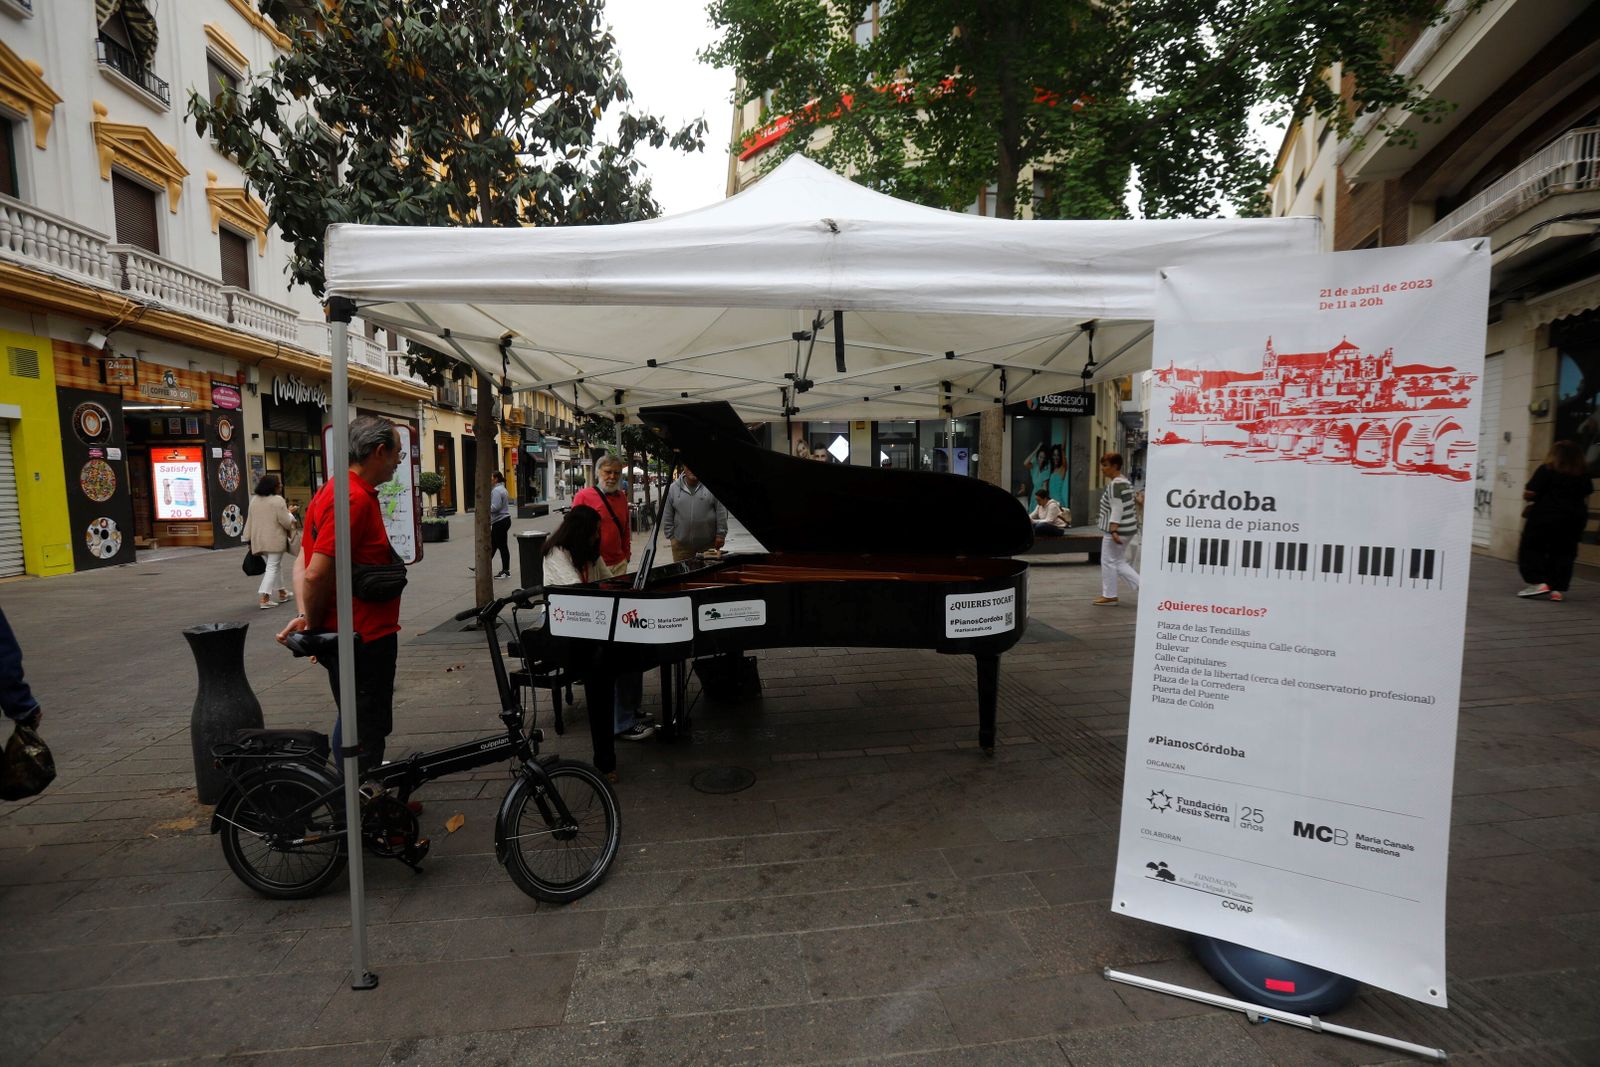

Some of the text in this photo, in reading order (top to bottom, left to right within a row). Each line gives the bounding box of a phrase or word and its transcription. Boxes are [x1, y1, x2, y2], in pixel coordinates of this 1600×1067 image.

[1320, 279, 1433, 298] 21 de abril de 2023
[1320, 302, 1334, 310] De
[1337, 301, 1346, 309] 11
[1360, 297, 1383, 307] 20h
[150, 387, 170, 396] COFFEE
[170, 390, 178, 398] TO
[160, 466, 198, 474] Satisfyer
[1166, 489, 1277, 512] Córdoba
[170, 510, 192, 518] 20 €
[1166, 516, 1300, 532] se llena de pianos
[950, 599, 992, 610] ¿QUIERES
[1157, 600, 1268, 617] ¿Quieres tocarlos?
[595, 610, 606, 620] 25
[622, 609, 638, 624] OFF
[630, 618, 656, 630] MCB
[1157, 621, 1250, 636] Plaza de las Tendillas
[1156, 632, 1336, 656] Calle Cruz Conde esquina Calle Góngora
[1156, 642, 1190, 652] Bulevar
[1154, 653, 1227, 667] Calle Capitulares
[1154, 674, 1246, 692] Plaza de la Corredera
[1154, 664, 1436, 704] Avenida de la libertad (cerca del conservatorio profesional)
[1152, 684, 1230, 700] Puerta del Puente
[1152, 694, 1214, 710] Plaza de Colón
[480, 738, 509, 750] quipplan
[1148, 736, 1246, 758] #PianosCórdoba
[1146, 759, 1186, 770] ORGANIZAN
[1176, 796, 1264, 824] Fundación 25
[1176, 806, 1264, 832] Jesús Serra años
[1140, 828, 1182, 842] COLABORAN
[1293, 820, 1348, 846] MCB
[1383, 839, 1414, 851] Canals
[1355, 842, 1400, 858] Barcelona
[1194, 873, 1238, 888] FUNDACIÓN
[1222, 900, 1253, 914] COVAP
